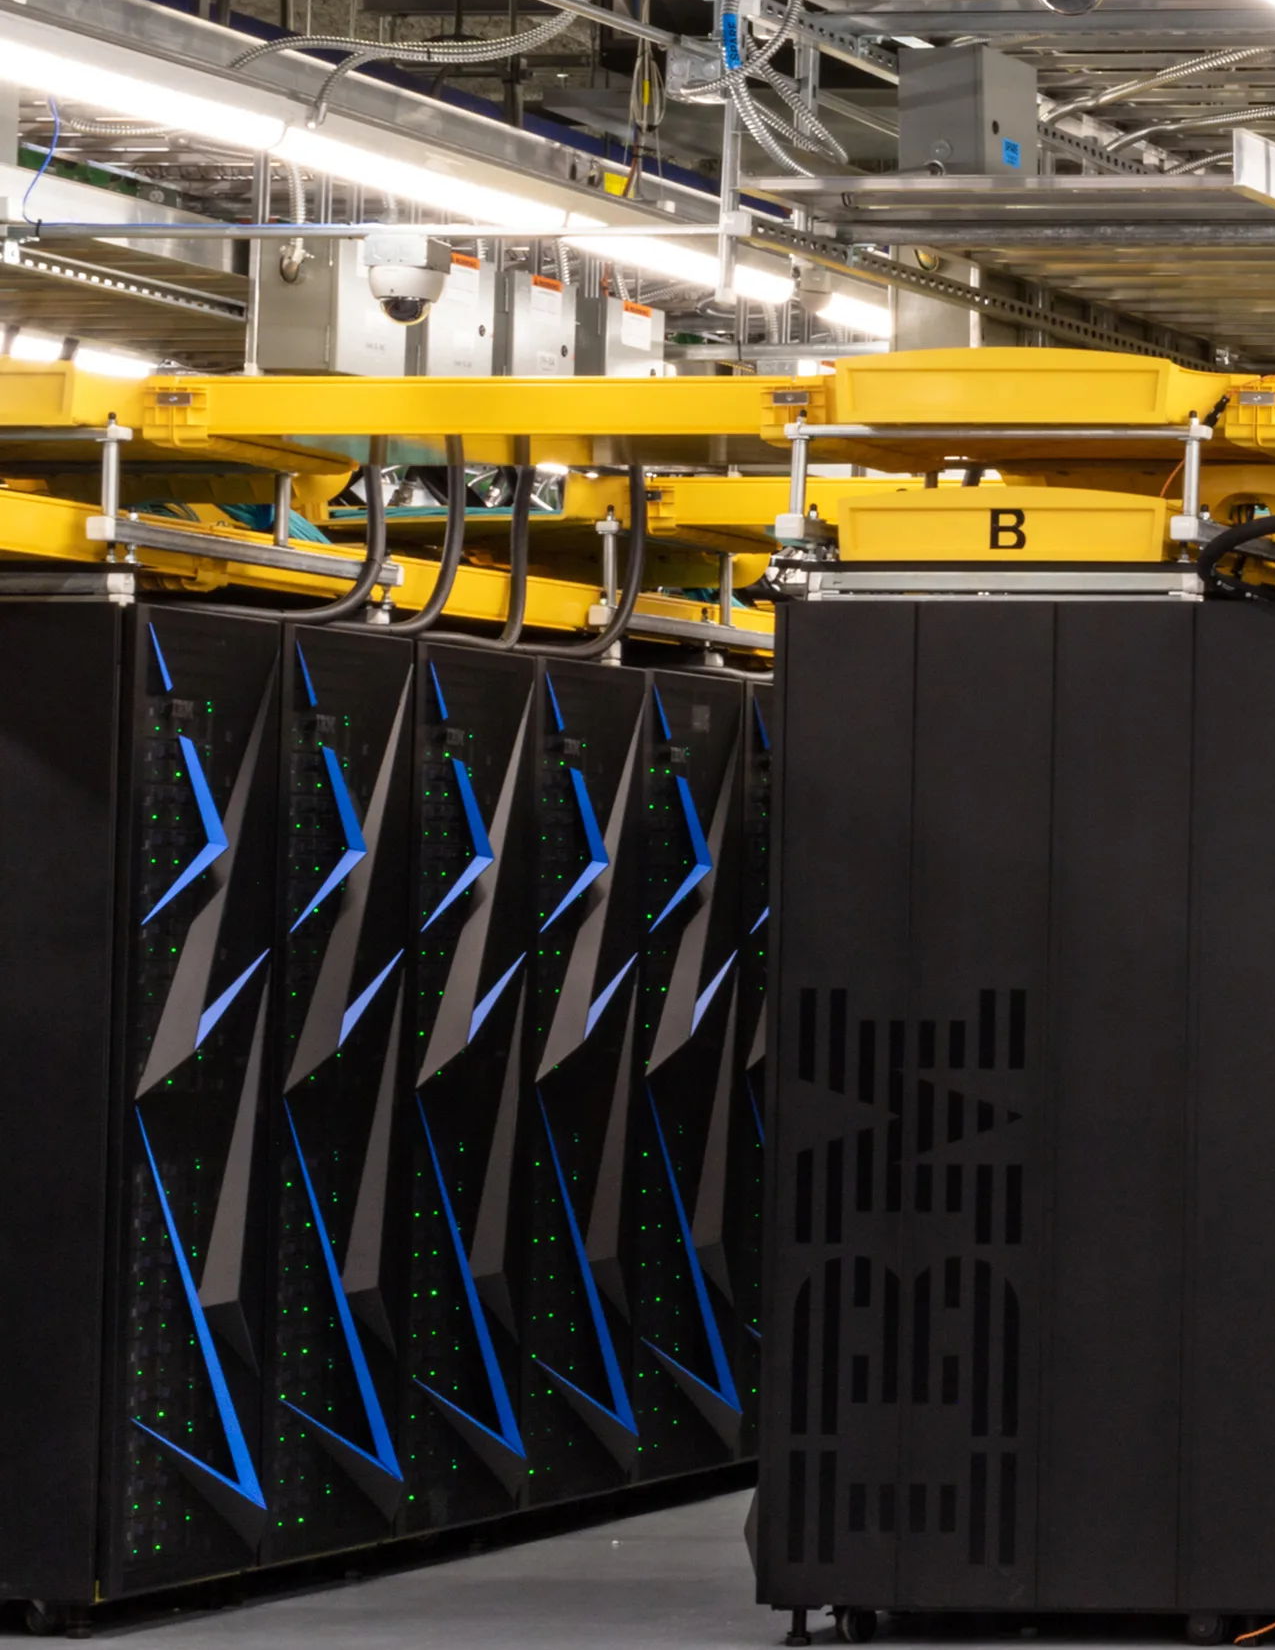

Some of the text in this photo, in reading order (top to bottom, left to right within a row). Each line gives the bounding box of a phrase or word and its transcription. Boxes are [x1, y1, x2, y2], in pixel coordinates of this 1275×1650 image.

[727, 21, 739, 61] SPARE
[989, 508, 1027, 550] B
[787, 987, 1027, 1565] IBM
